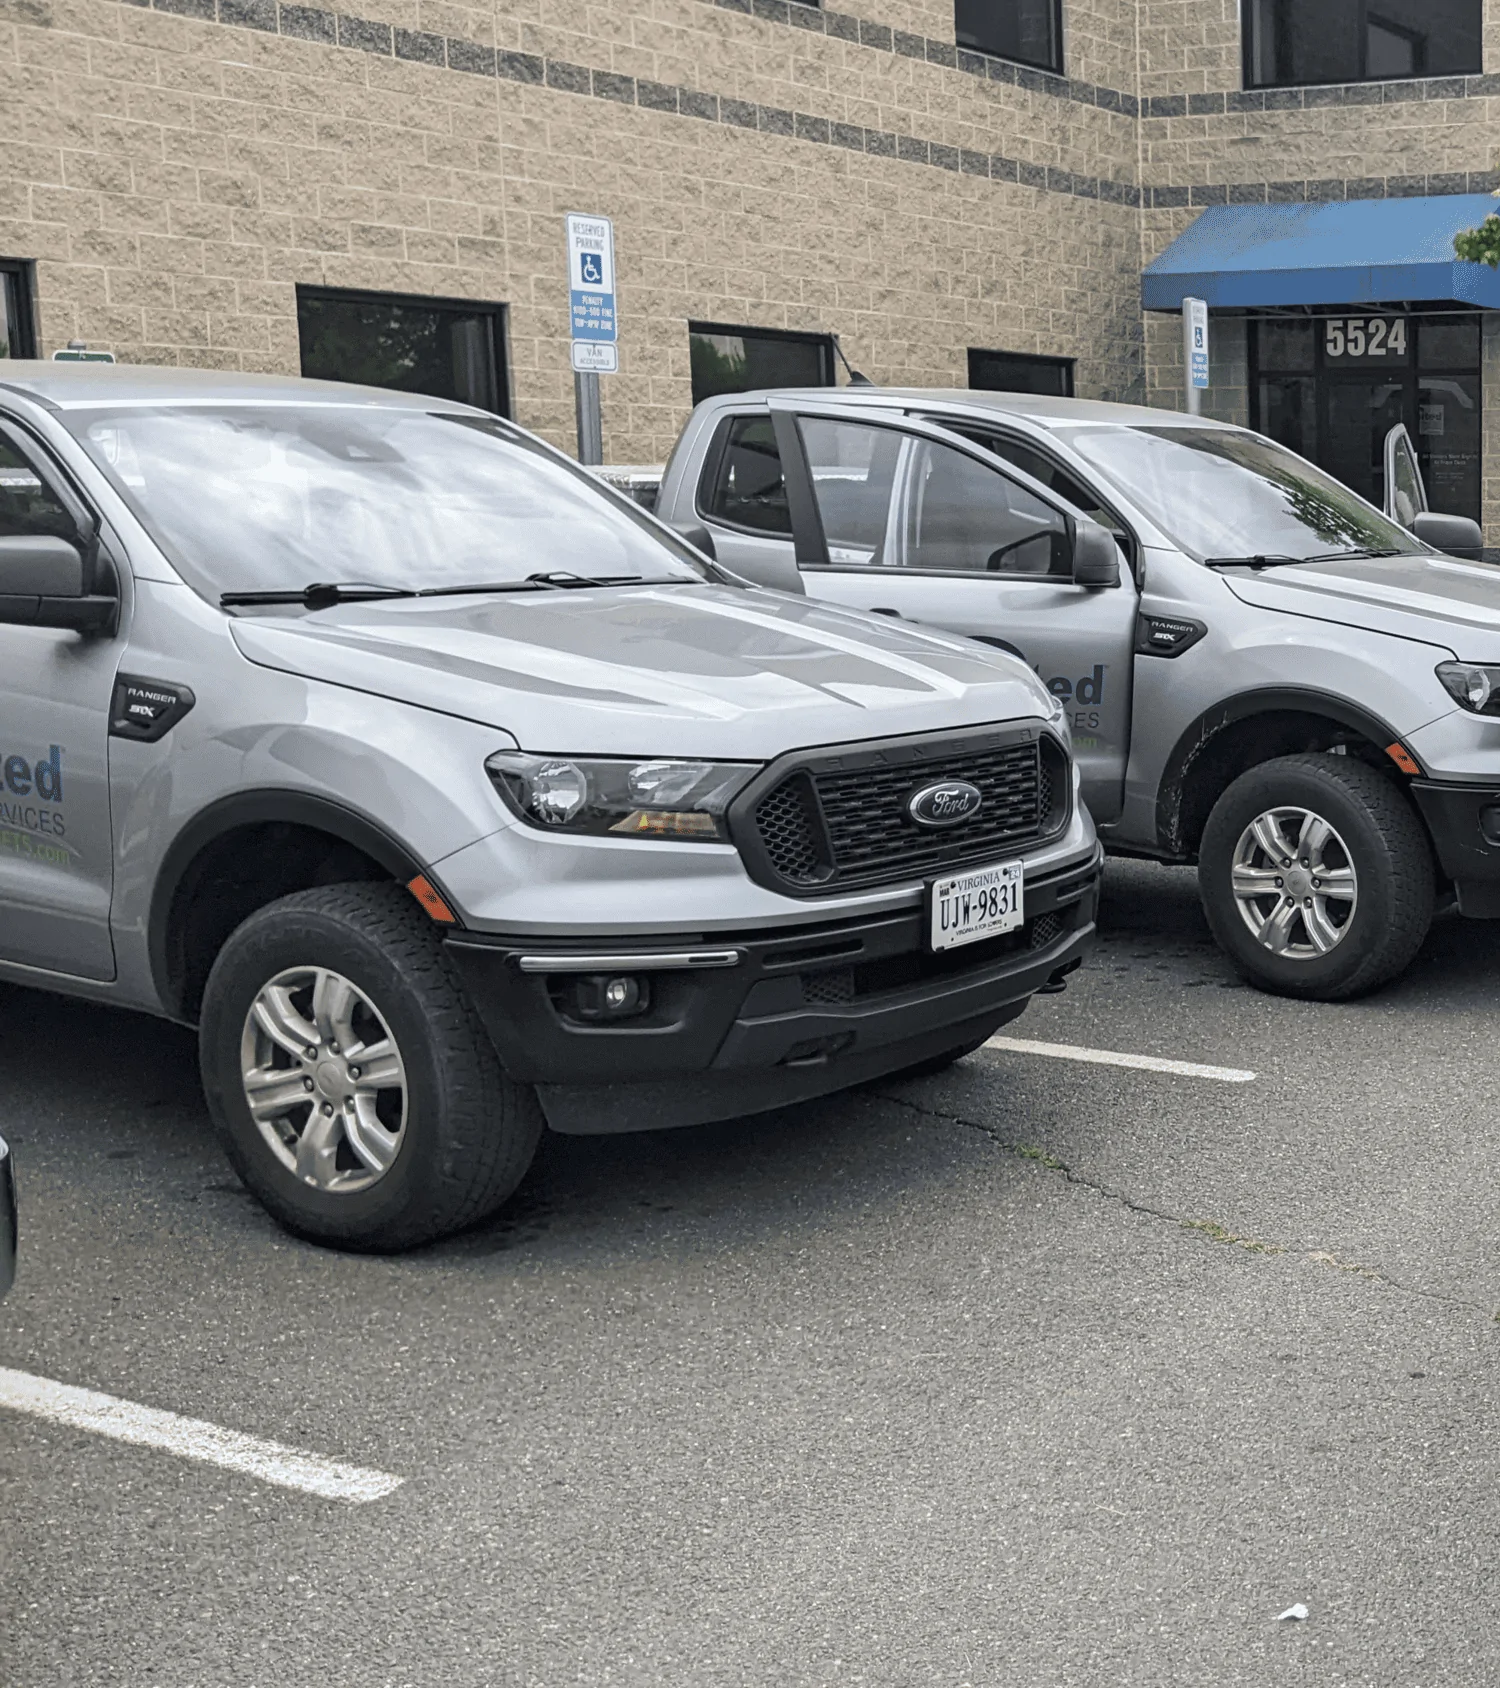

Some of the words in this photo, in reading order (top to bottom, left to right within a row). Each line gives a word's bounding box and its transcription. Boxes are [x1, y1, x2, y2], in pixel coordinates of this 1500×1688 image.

[572, 222, 605, 238] RESERVED
[576, 236, 604, 251] PARKING
[1326, 318, 1407, 357] 5524
[587, 348, 602, 357] VAN
[1151, 621, 1194, 633] RANGER
[1153, 632, 1175, 641] STX
[1035, 664, 1104, 705] ed
[128, 688, 177, 704] RANGER
[129, 704, 155, 717] STX
[0, 744, 63, 803] ed
[932, 789, 969, 816] Ford
[957, 872, 1000, 891] VIRGINIA
[939, 887, 950, 897] MAR
[940, 882, 1018, 932] UJW-9831
